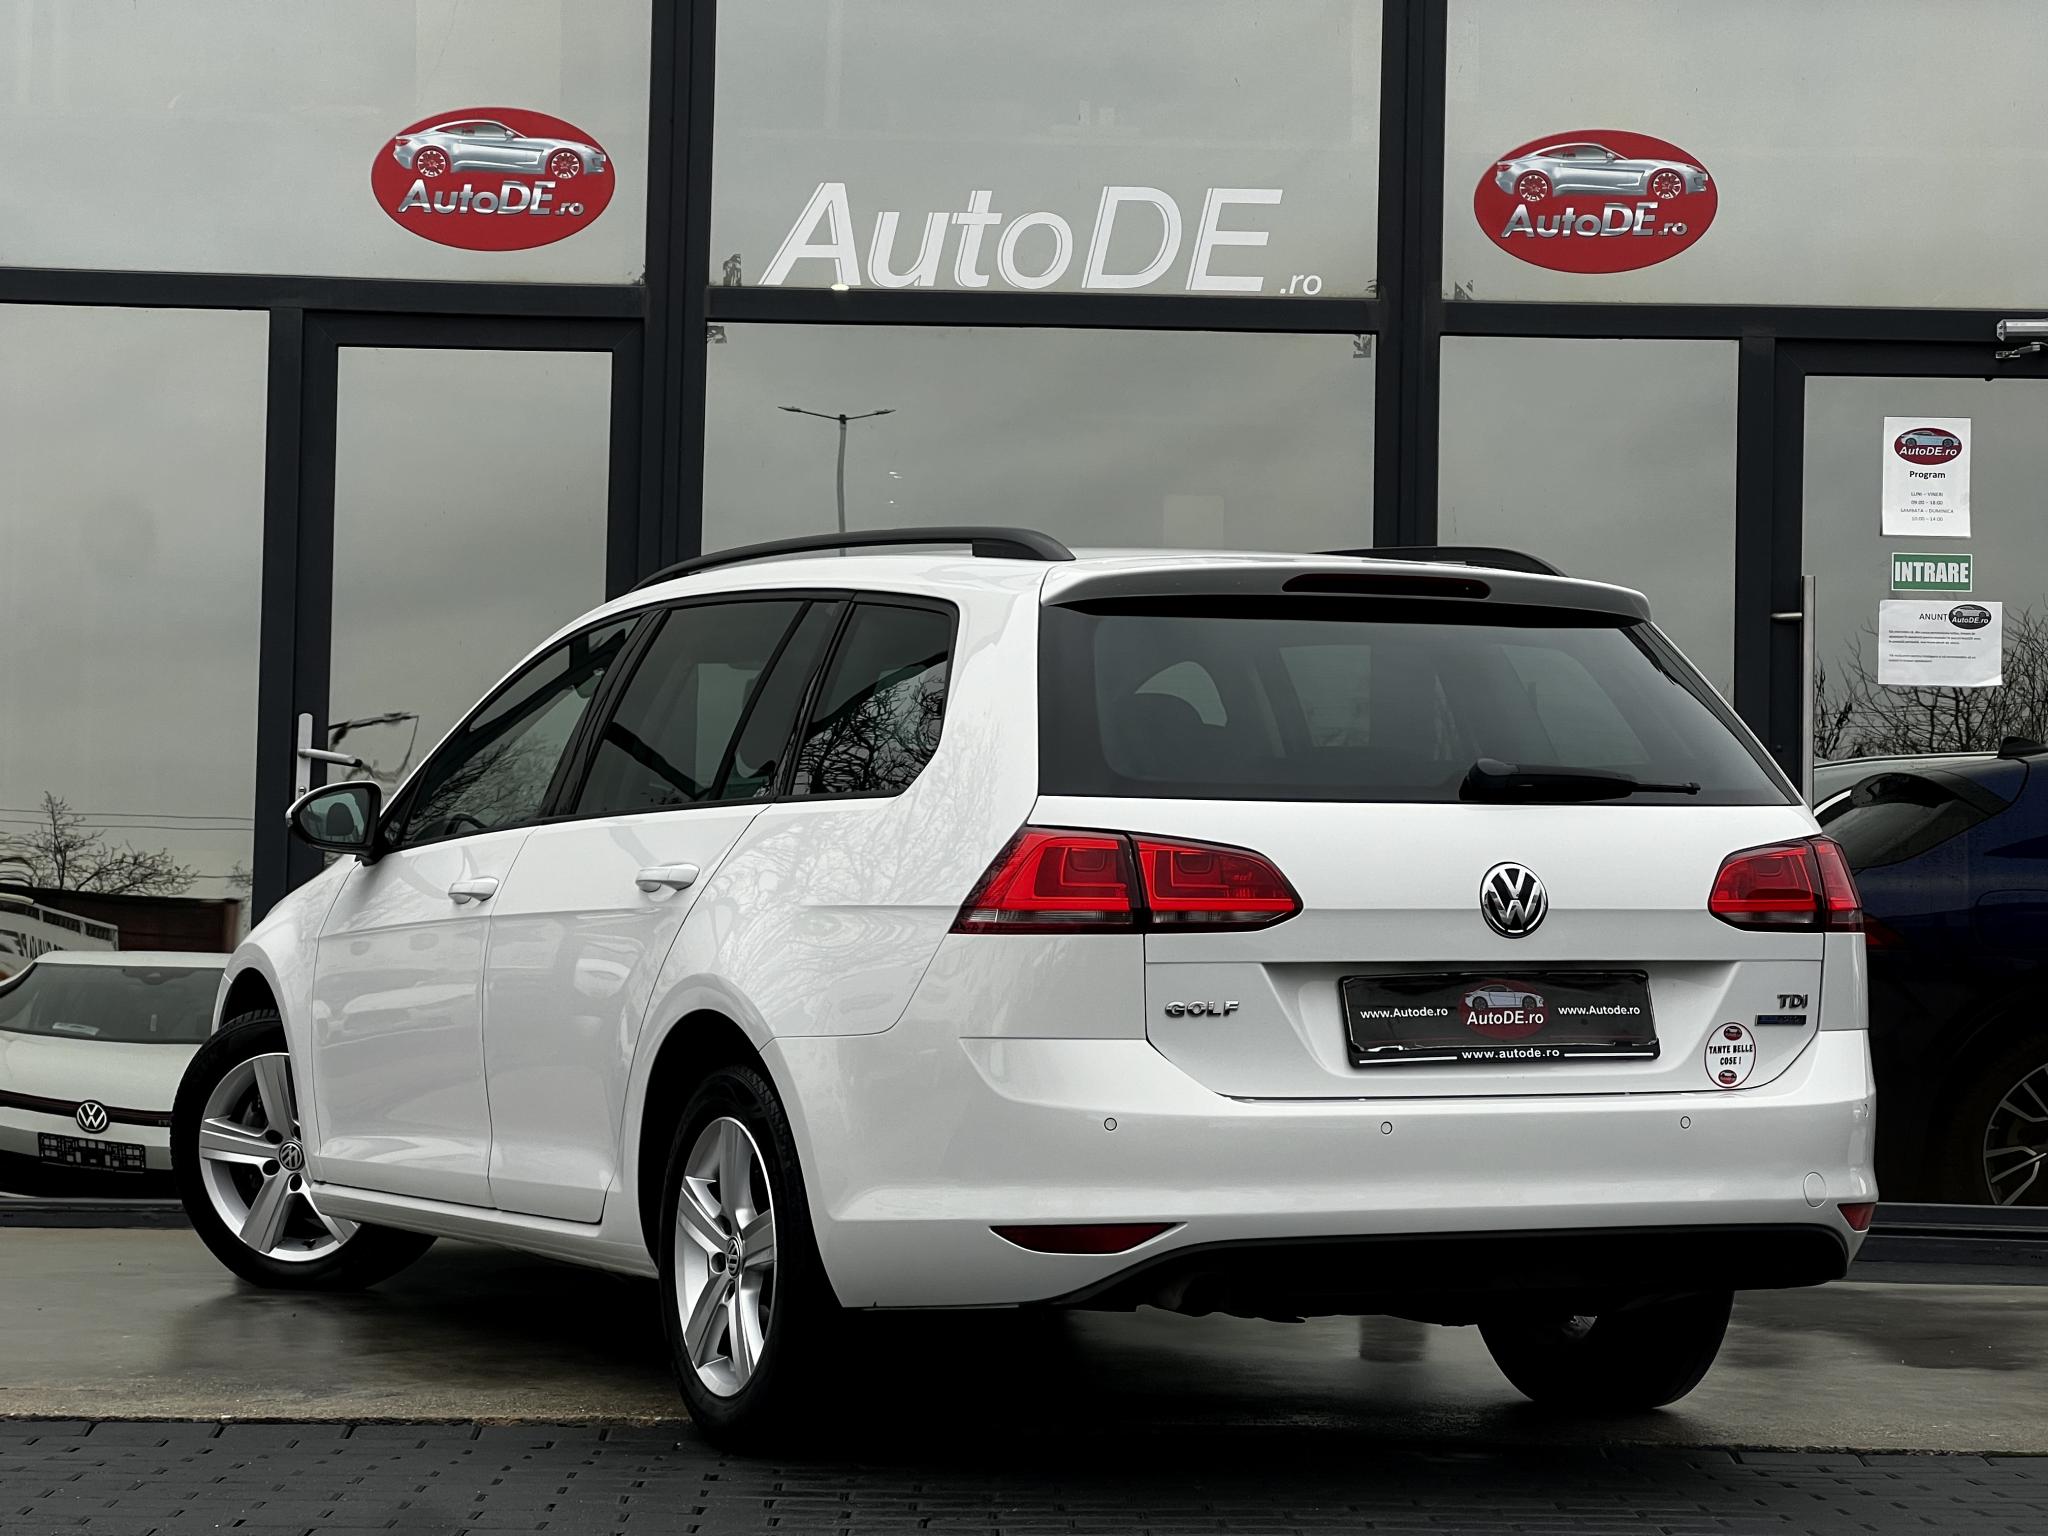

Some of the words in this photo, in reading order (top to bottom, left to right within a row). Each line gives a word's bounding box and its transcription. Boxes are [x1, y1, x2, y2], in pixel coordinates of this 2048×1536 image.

[1899, 446, 1957, 456] AutoDE.ro
[1909, 471, 1946, 479] Program
[1894, 561, 1969, 583] INTRARE
[1952, 616, 1989, 624] AutoDE.ro
[1165, 1000, 1240, 1018] GOLF
[1360, 1007, 1448, 1019] www.Autode.ro
[1557, 1005, 1640, 1016] www.Autode.ro
[1466, 1010, 1544, 1025] AutoDE.ro
[1461, 1047, 1560, 1060] www.autode.ro
[1709, 1045, 1731, 1054] TANTE
[1732, 1044, 1753, 1053] BELLE
[1719, 1057, 1737, 1065] COSE
